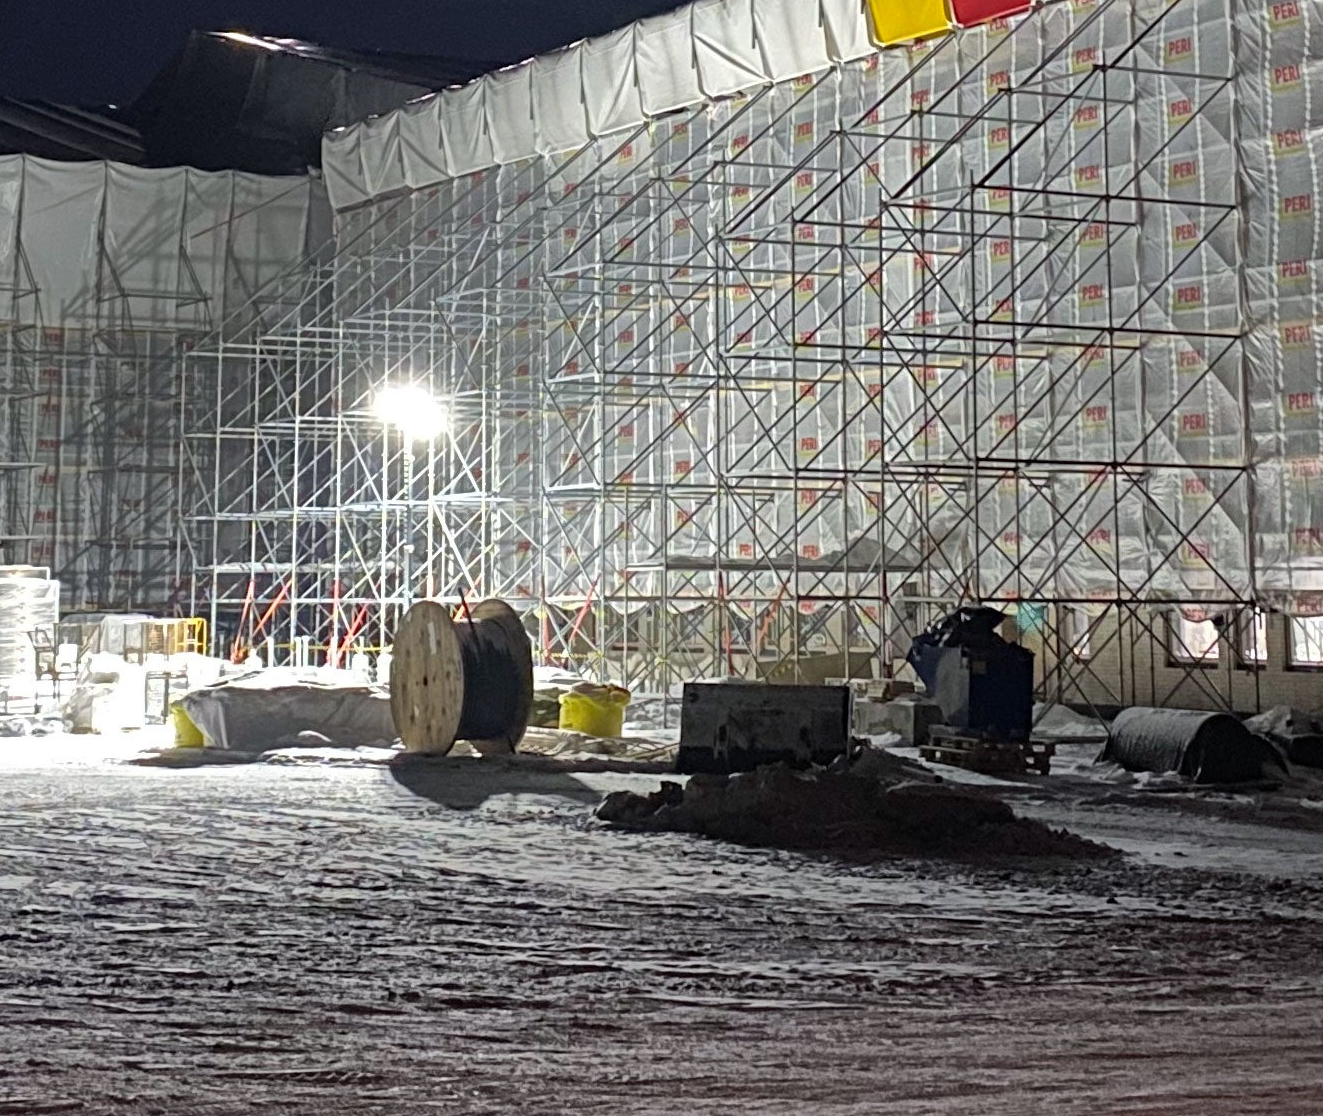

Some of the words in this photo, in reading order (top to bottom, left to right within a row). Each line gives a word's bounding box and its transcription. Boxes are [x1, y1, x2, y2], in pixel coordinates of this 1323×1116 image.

[1274, 2, 1299, 19] PERI
[1170, 39, 1192, 55] PERI
[1275, 65, 1300, 82] PERI
[1171, 100, 1192, 116] PERI
[1277, 130, 1302, 146] PERI
[1174, 162, 1196, 178] PERI
[1285, 195, 1311, 211] PERI
[1177, 224, 1197, 240] PERI
[1282, 261, 1307, 277] PERI
[1179, 286, 1200, 302] PERI
[1285, 326, 1310, 342] PERI
[1289, 394, 1314, 409] PERI
[1183, 414, 1206, 430] PERI
